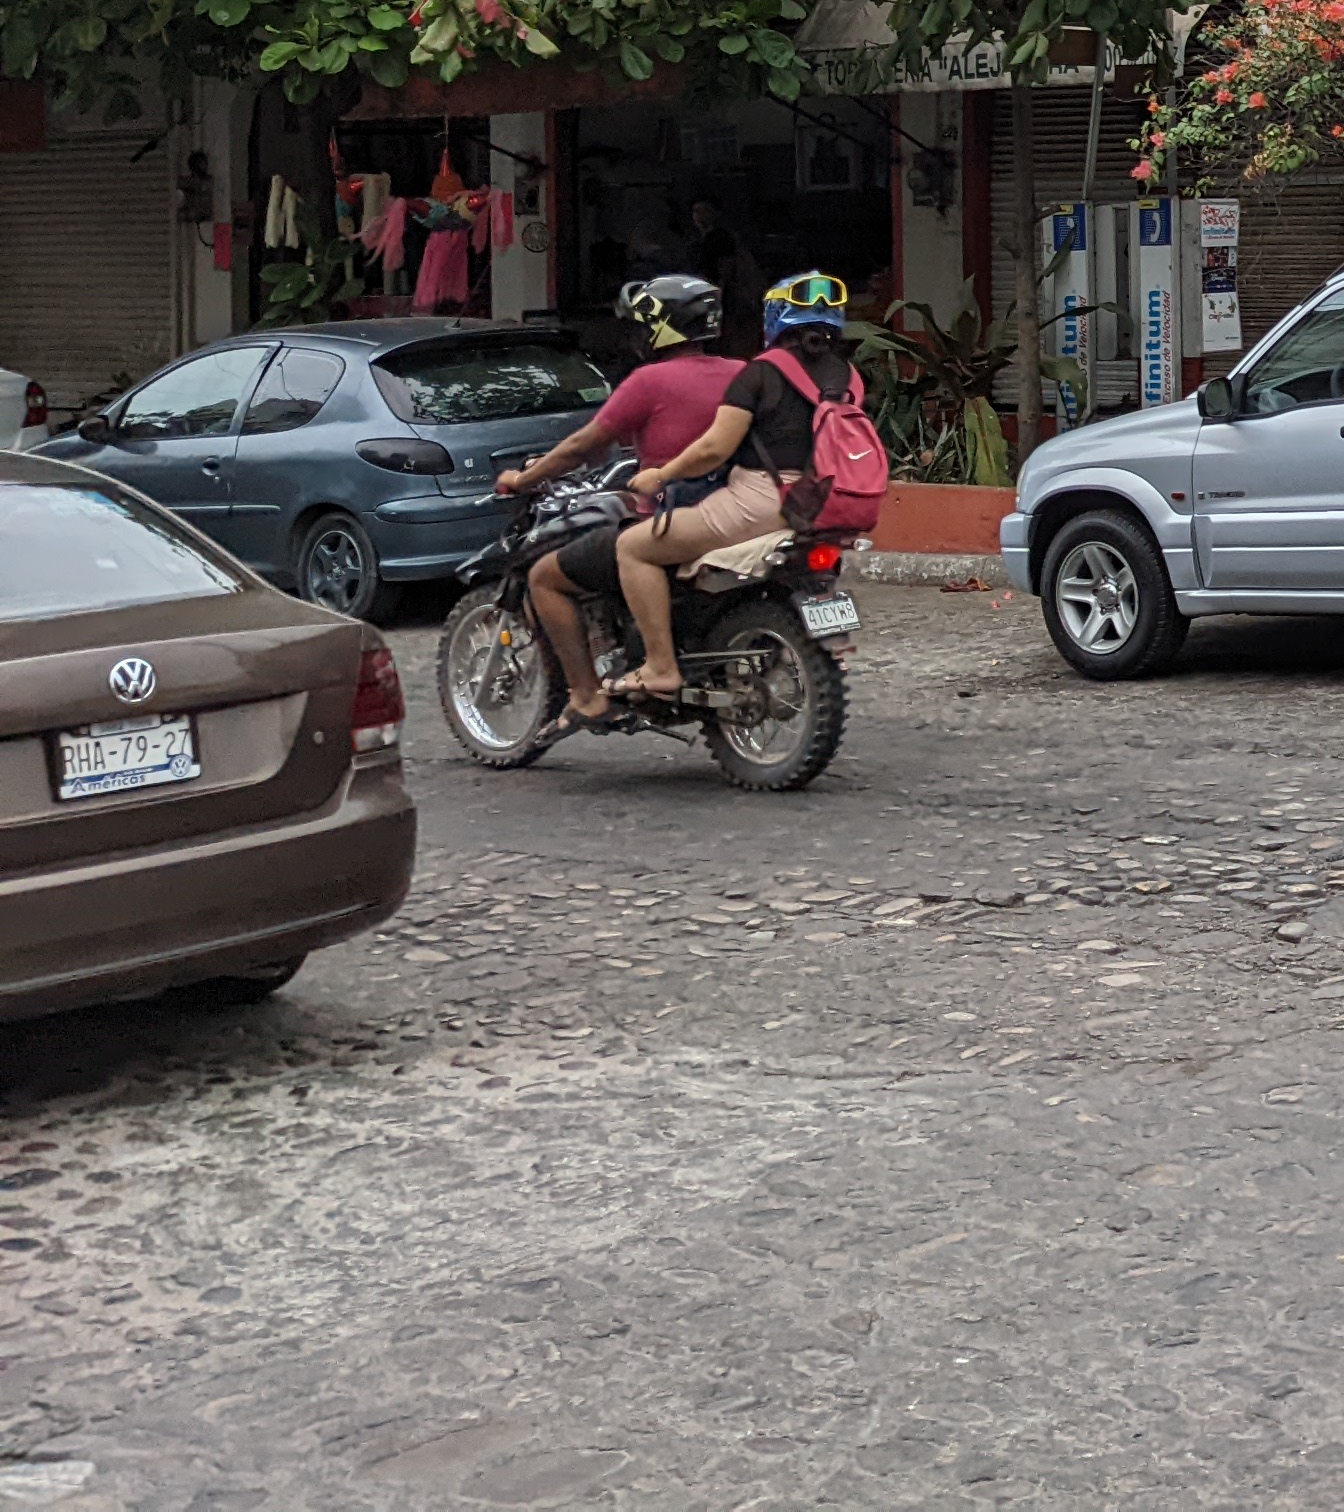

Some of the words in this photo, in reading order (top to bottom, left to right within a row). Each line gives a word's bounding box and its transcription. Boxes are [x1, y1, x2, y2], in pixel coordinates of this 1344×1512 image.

[1161, 289, 1171, 345] Velocidad
[1161, 347, 1171, 363] de
[63, 728, 190, 775] RHA-79-27
